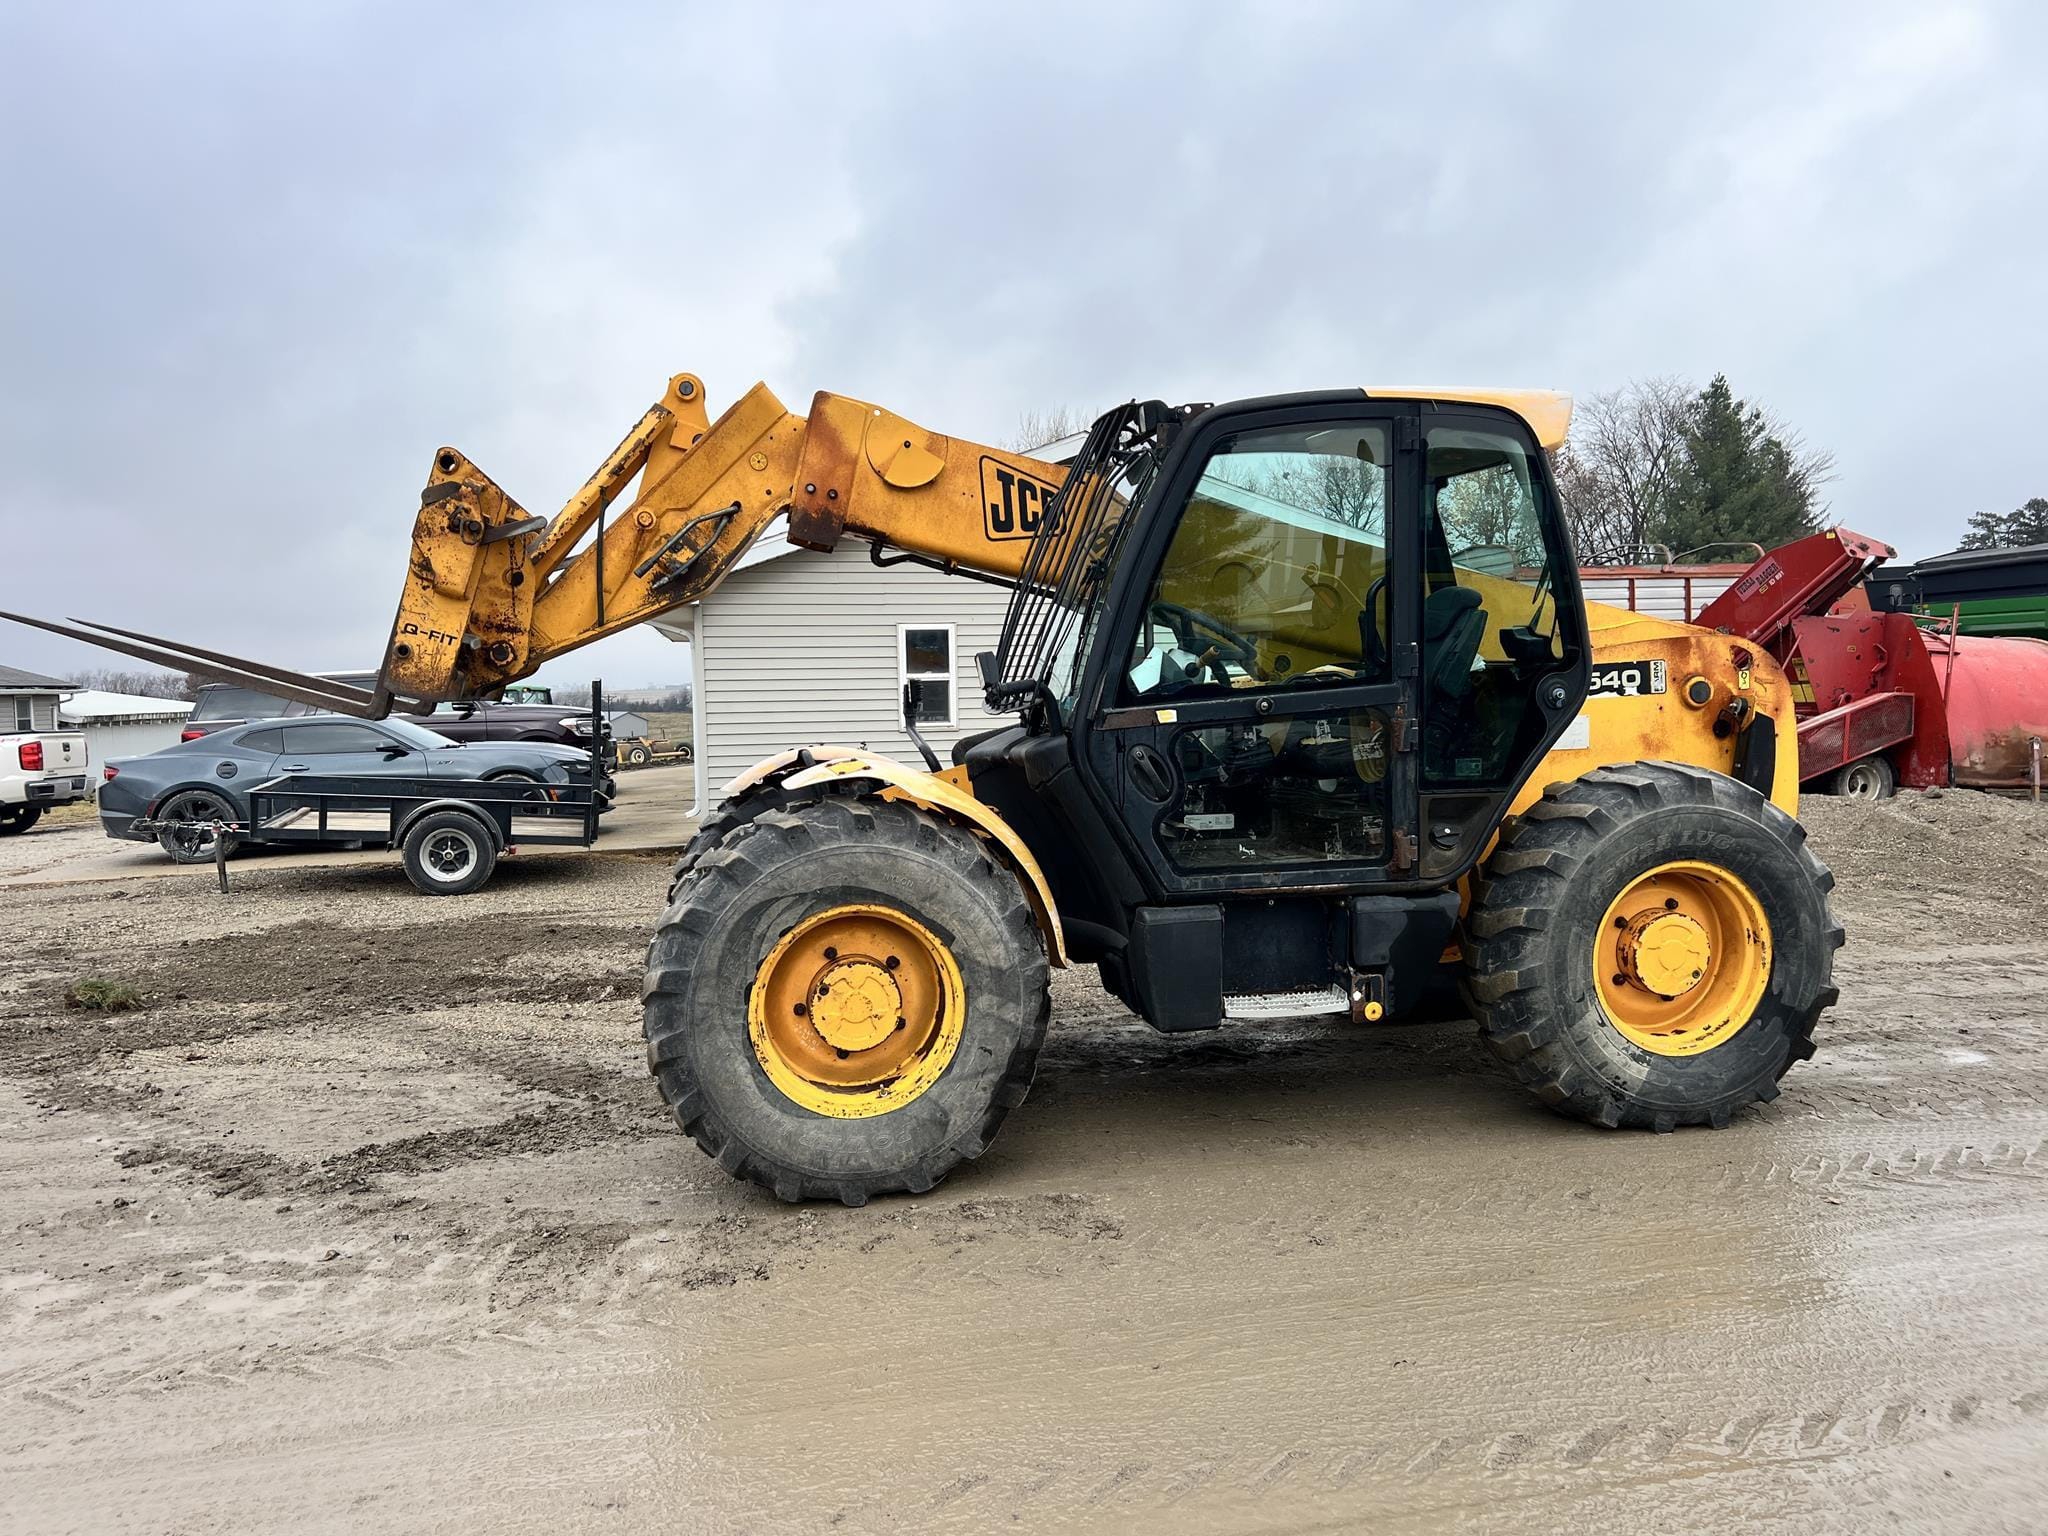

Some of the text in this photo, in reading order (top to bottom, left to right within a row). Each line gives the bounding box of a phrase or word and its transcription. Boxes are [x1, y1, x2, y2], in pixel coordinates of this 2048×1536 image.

[403, 623, 458, 645] Q-FIT
[1590, 669, 1641, 690] 540
[1678, 830, 1735, 849] LUG
[882, 873, 914, 888] NYLON
